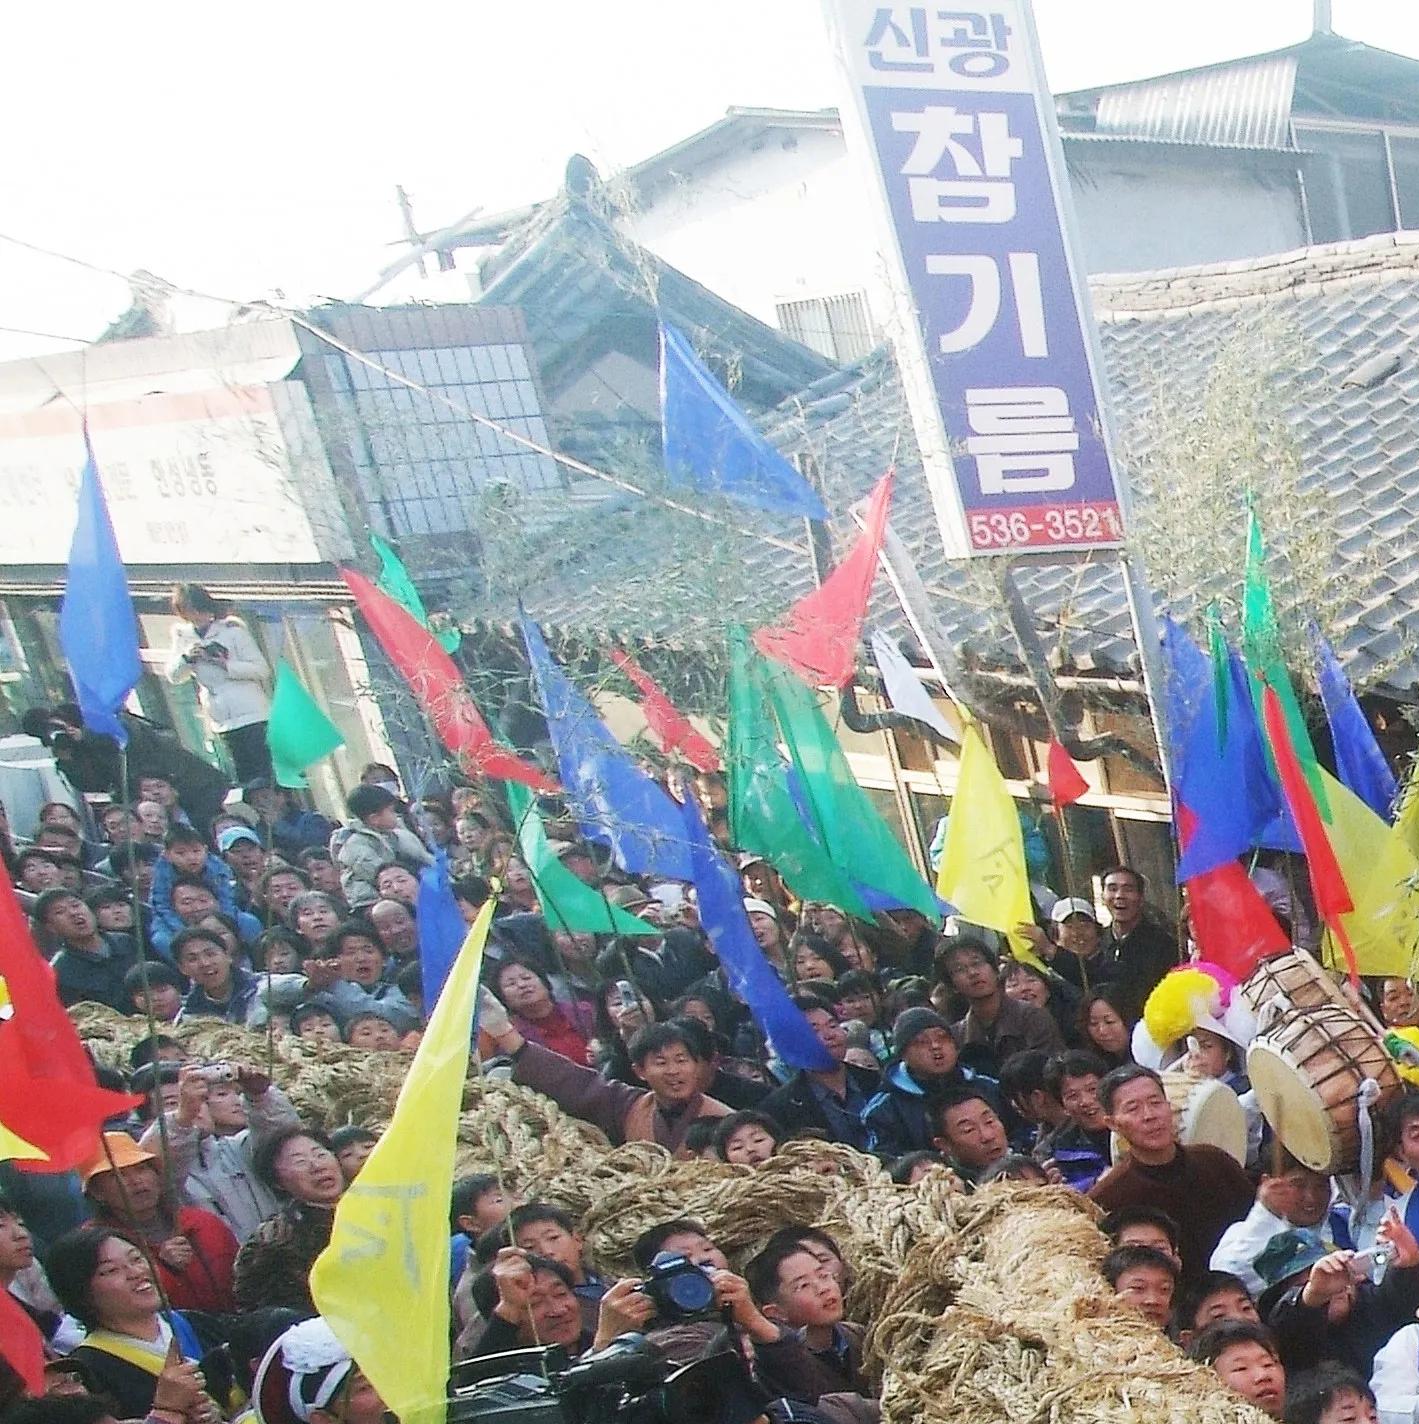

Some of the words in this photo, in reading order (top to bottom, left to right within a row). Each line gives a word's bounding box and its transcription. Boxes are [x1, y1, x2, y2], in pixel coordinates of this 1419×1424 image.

[863, 6, 1012, 80] 신광
[890, 105, 1081, 498] 참기름
[970, 508, 1123, 547] 536-3521
